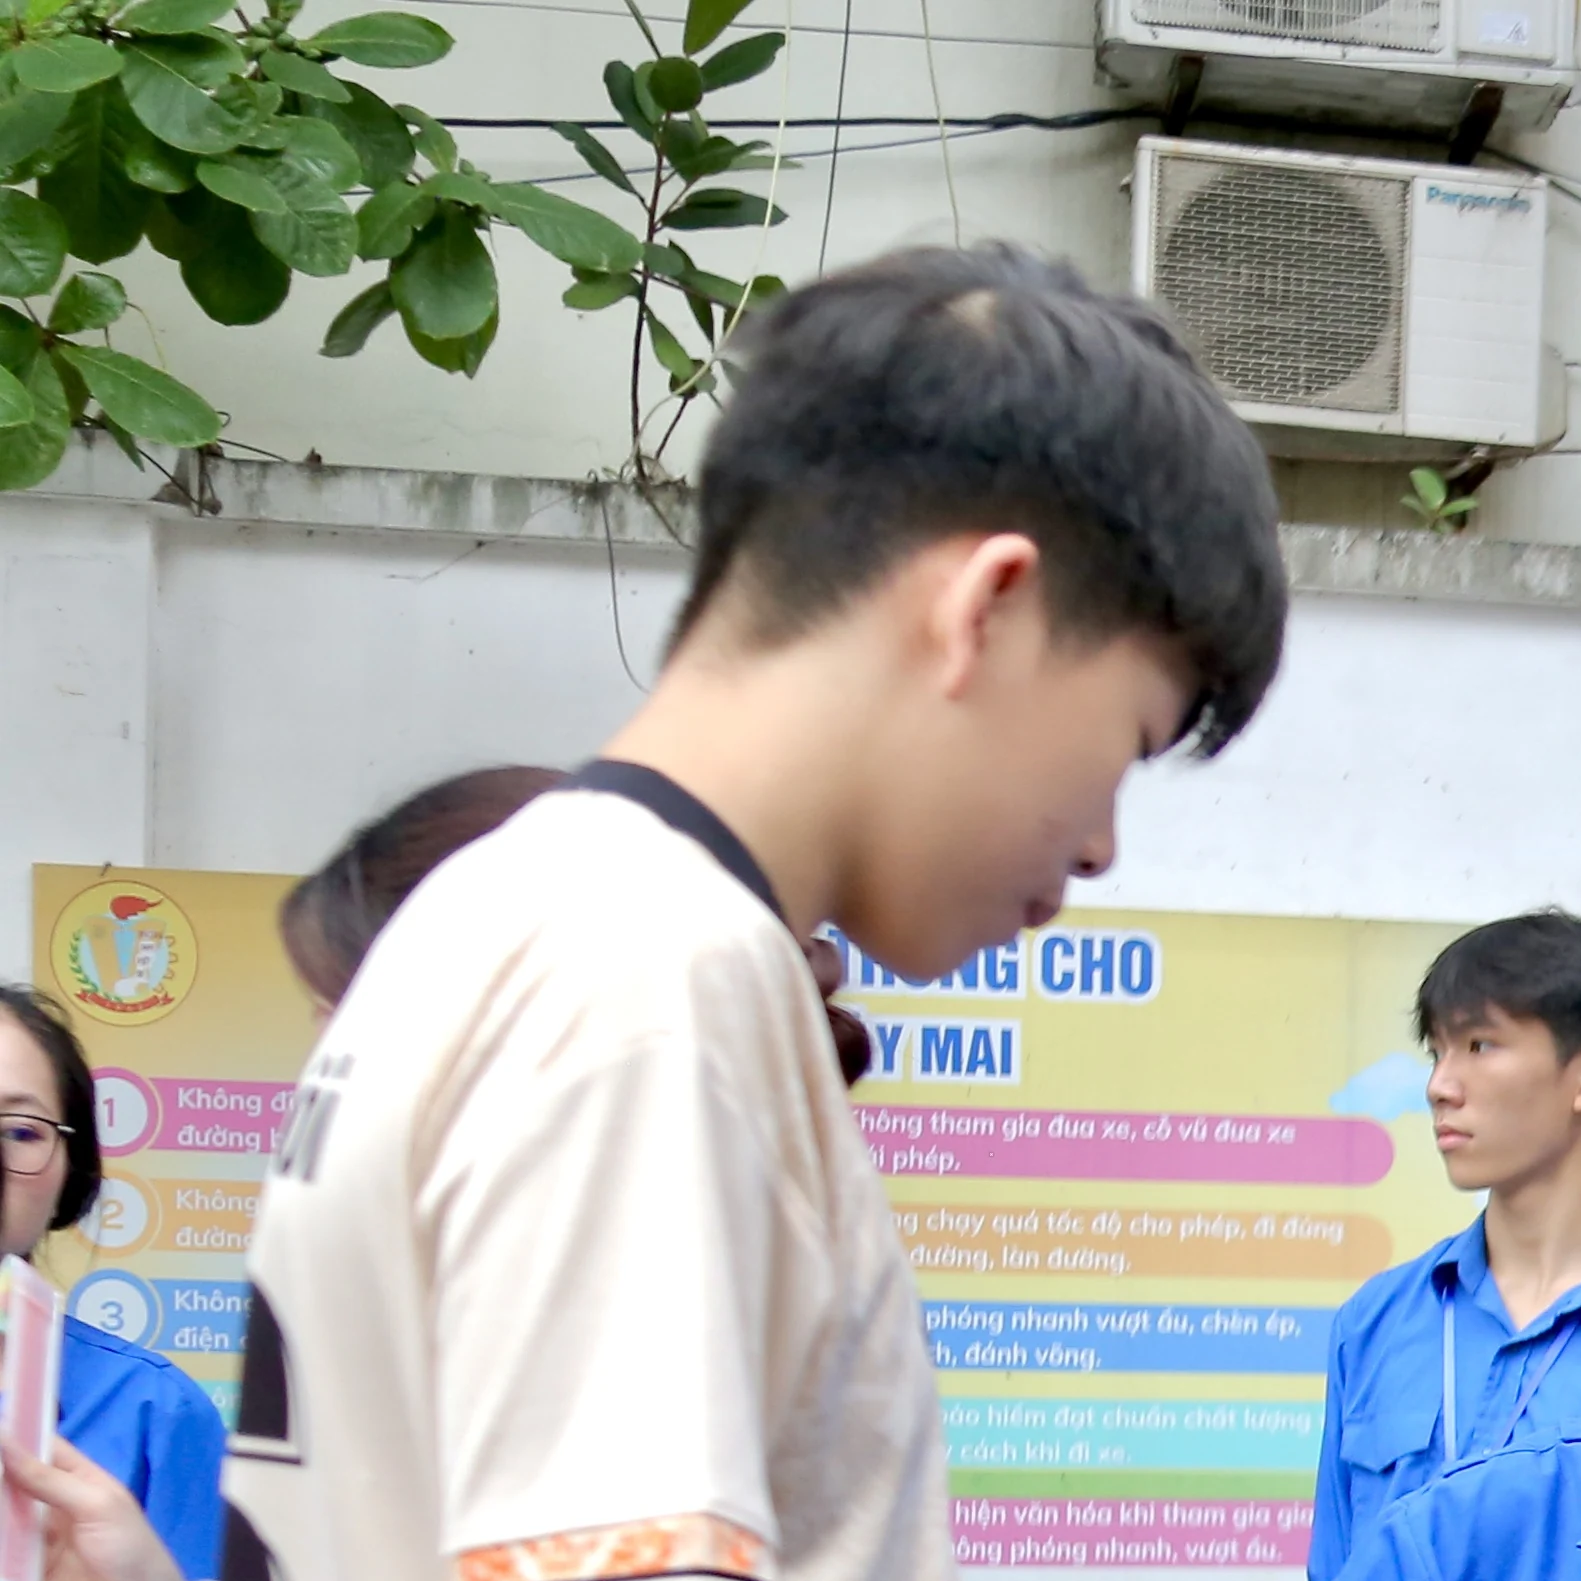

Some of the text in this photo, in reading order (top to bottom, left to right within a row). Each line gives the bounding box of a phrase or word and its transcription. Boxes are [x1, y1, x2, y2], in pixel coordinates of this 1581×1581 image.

[1041, 936, 1153, 995] CHO
[921, 1027, 1013, 1078] MAI
[102, 1097, 114, 1127] 1
[177, 1087, 262, 1117] Không
[177, 1124, 261, 1154] đường
[855, 1108, 923, 1139] hông
[929, 1110, 994, 1136] tham
[1001, 1113, 1041, 1142] gia
[1048, 1113, 1095, 1139] đua
[1267, 1124, 1296, 1145] xe
[100, 1199, 124, 1230] 2
[926, 1208, 985, 1237] chạy
[992, 1209, 1039, 1237] quá
[1046, 1209, 1085, 1234] tốc
[1130, 1213, 1172, 1236] cho
[1253, 1216, 1277, 1239] đi
[1282, 1216, 1345, 1245] đúng
[99, 1300, 124, 1331] 3
[926, 1304, 1004, 1336] phóng
[1011, 1306, 1089, 1332] nhanh
[1096, 1309, 1150, 1338] vượt
[174, 1327, 229, 1353] điện
[964, 1340, 1028, 1368] đánh
[961, 1437, 1017, 1463] cách
[1025, 1438, 1060, 1464] khi
[1069, 1439, 1090, 1463] đi
[955, 1499, 1006, 1531] hiện
[1013, 1501, 1058, 1526] văn
[1120, 1502, 1155, 1527] khi
[1163, 1502, 1226, 1527] tham
[1232, 1504, 1271, 1533] gia
[1277, 1505, 1314, 1533] gia
[1009, 1536, 1088, 1566] phóng
[1185, 1539, 1240, 1565] vượt
